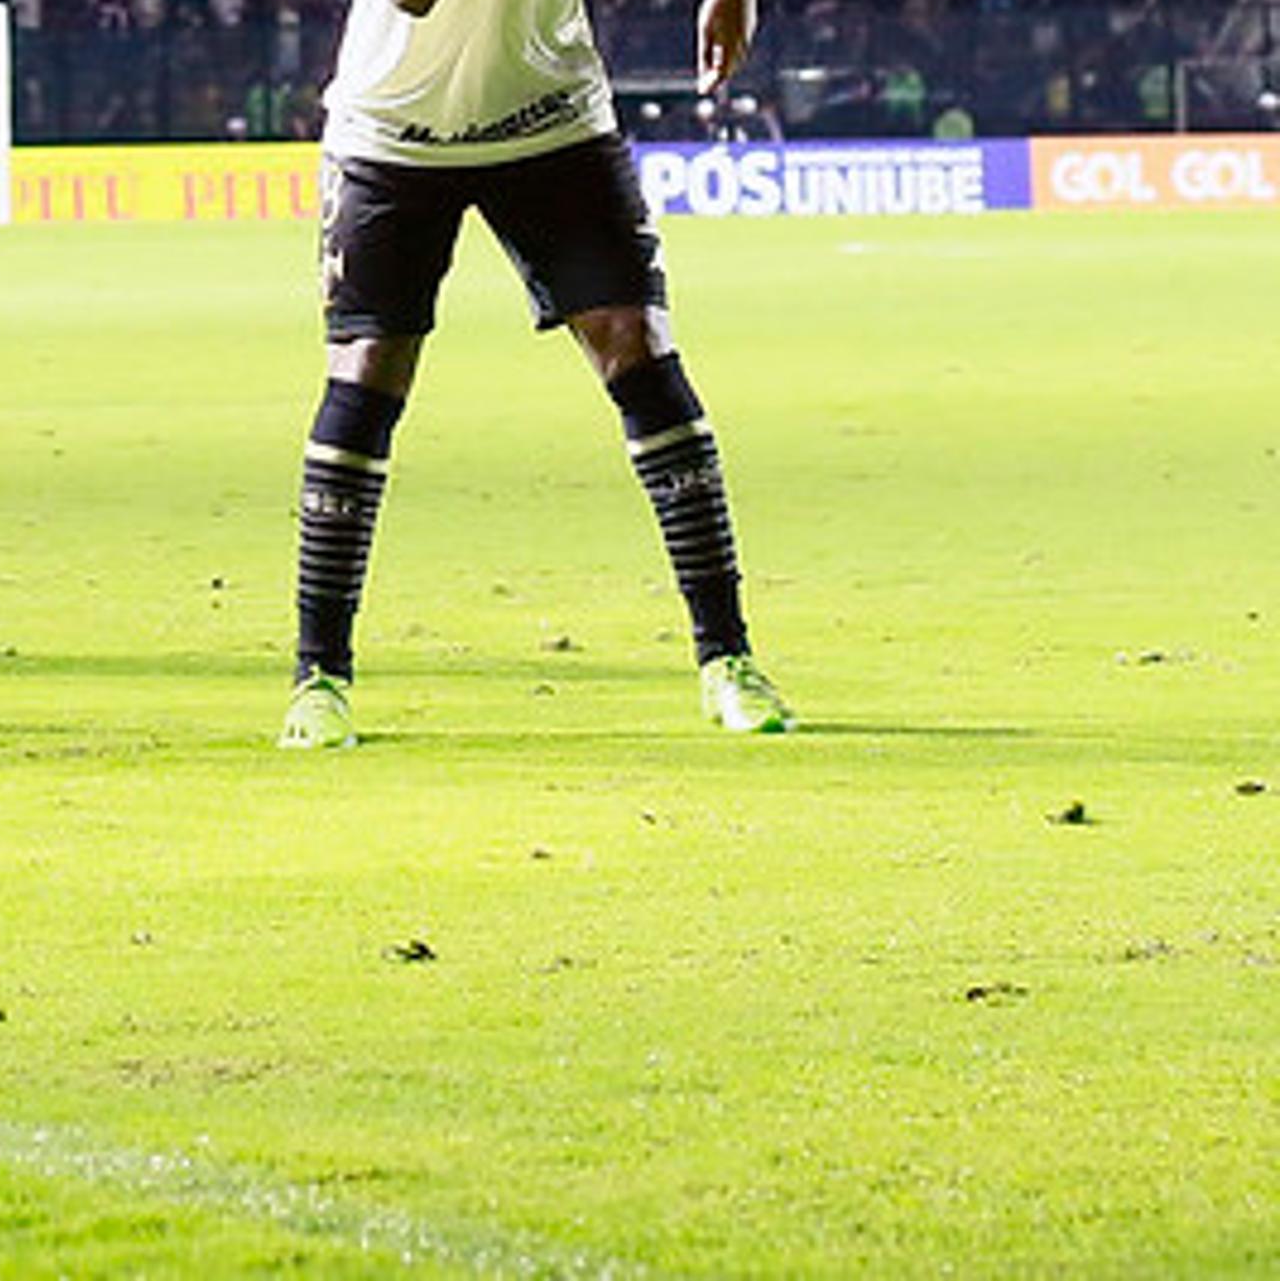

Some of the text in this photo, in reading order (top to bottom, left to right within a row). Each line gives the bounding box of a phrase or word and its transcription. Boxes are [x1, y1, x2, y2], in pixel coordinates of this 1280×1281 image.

[640, 141, 985, 216] PÓS UNIUBE
[1051, 150, 1278, 202] GOL GOL
